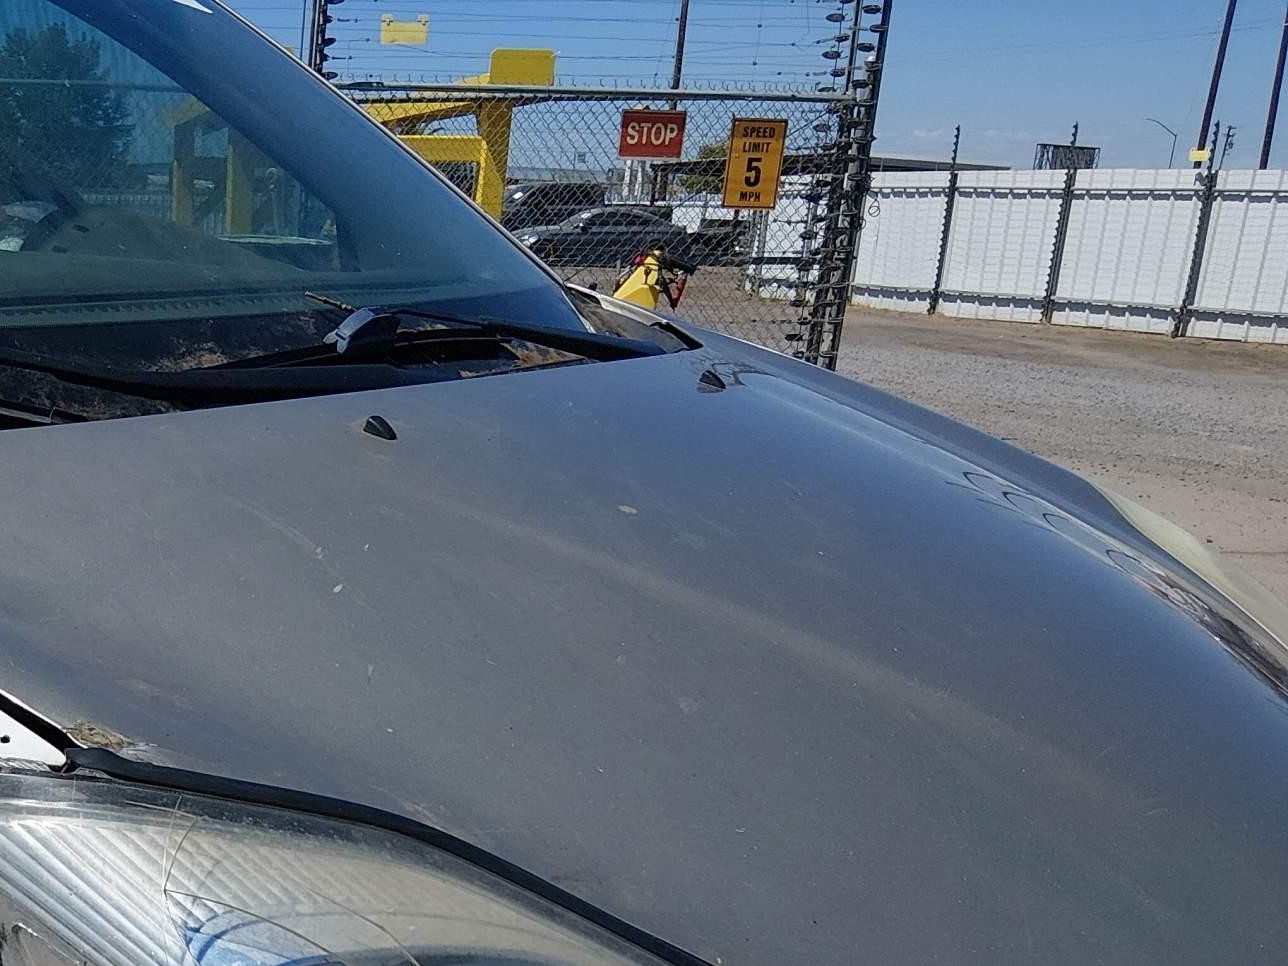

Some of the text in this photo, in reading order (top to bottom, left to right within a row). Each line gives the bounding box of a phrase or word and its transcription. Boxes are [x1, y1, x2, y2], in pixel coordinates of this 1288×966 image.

[626, 121, 678, 145] STOP
[742, 126, 776, 139] SPEED
[742, 141, 772, 153] LIMIT
[744, 157, 763, 188] 5
[739, 191, 761, 203] MPH
